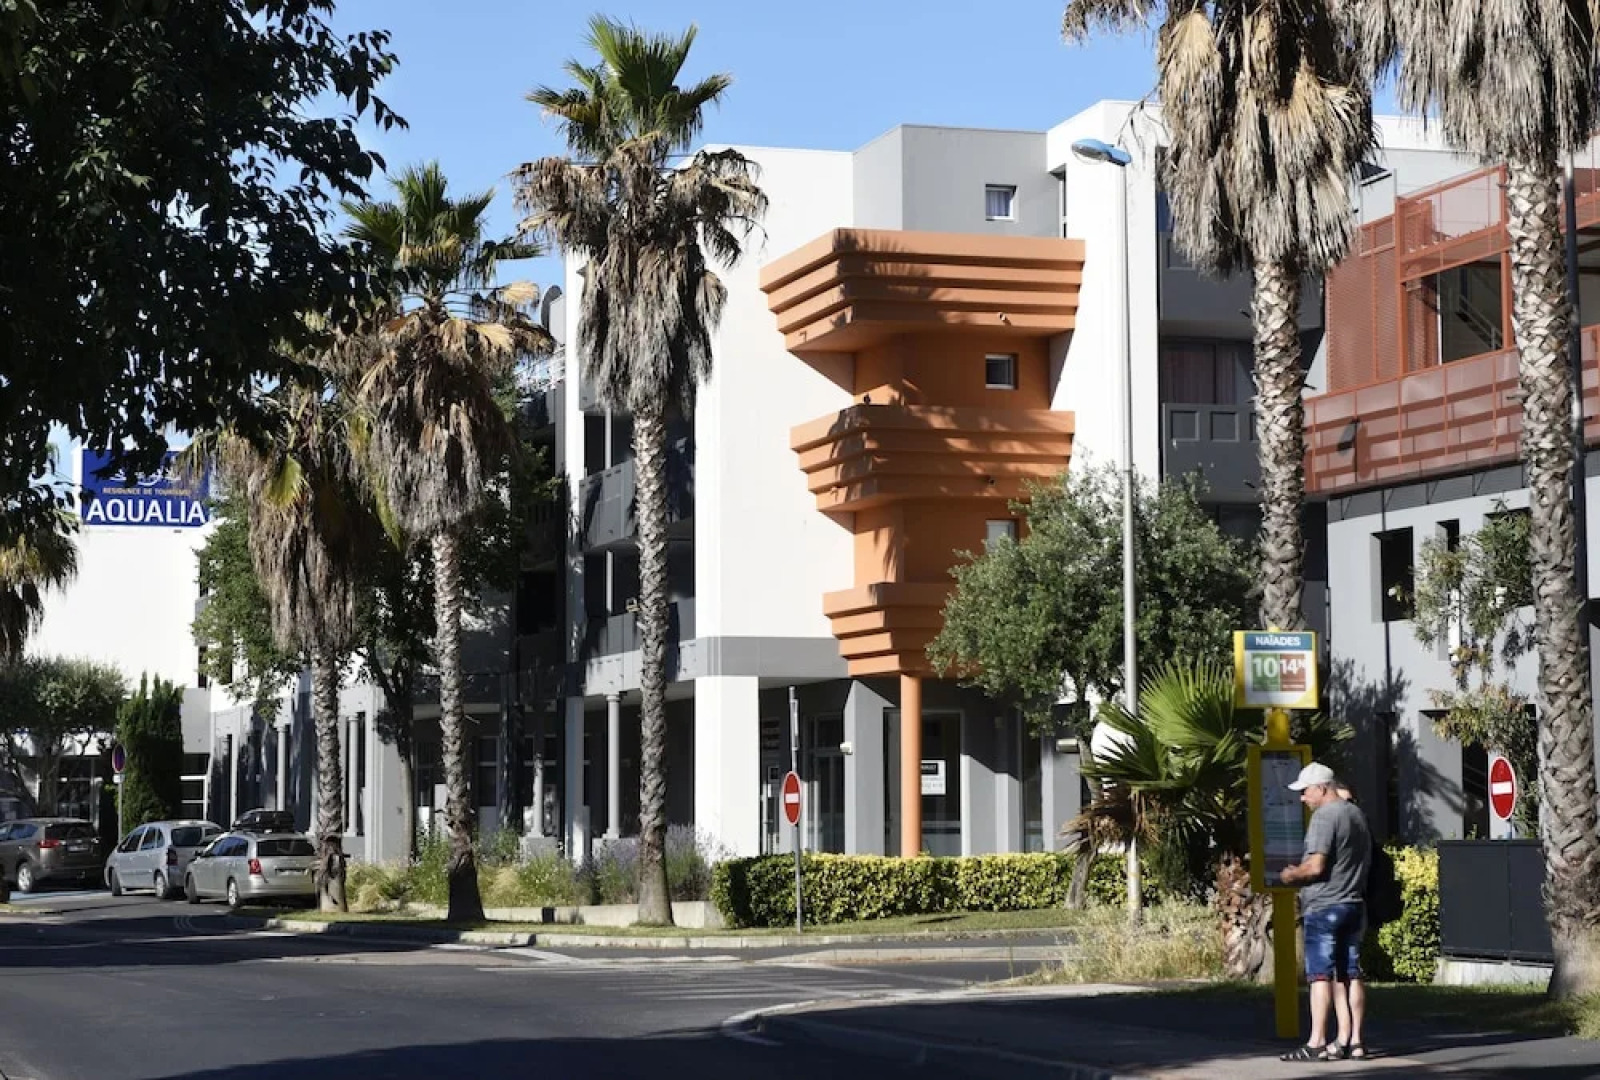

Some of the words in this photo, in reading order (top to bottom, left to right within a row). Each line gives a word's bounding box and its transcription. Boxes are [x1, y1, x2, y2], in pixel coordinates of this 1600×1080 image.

[86, 498, 206, 523] AQUALIA
[1255, 634, 1301, 646] NAÏADES
[1253, 657, 1277, 678] 10
